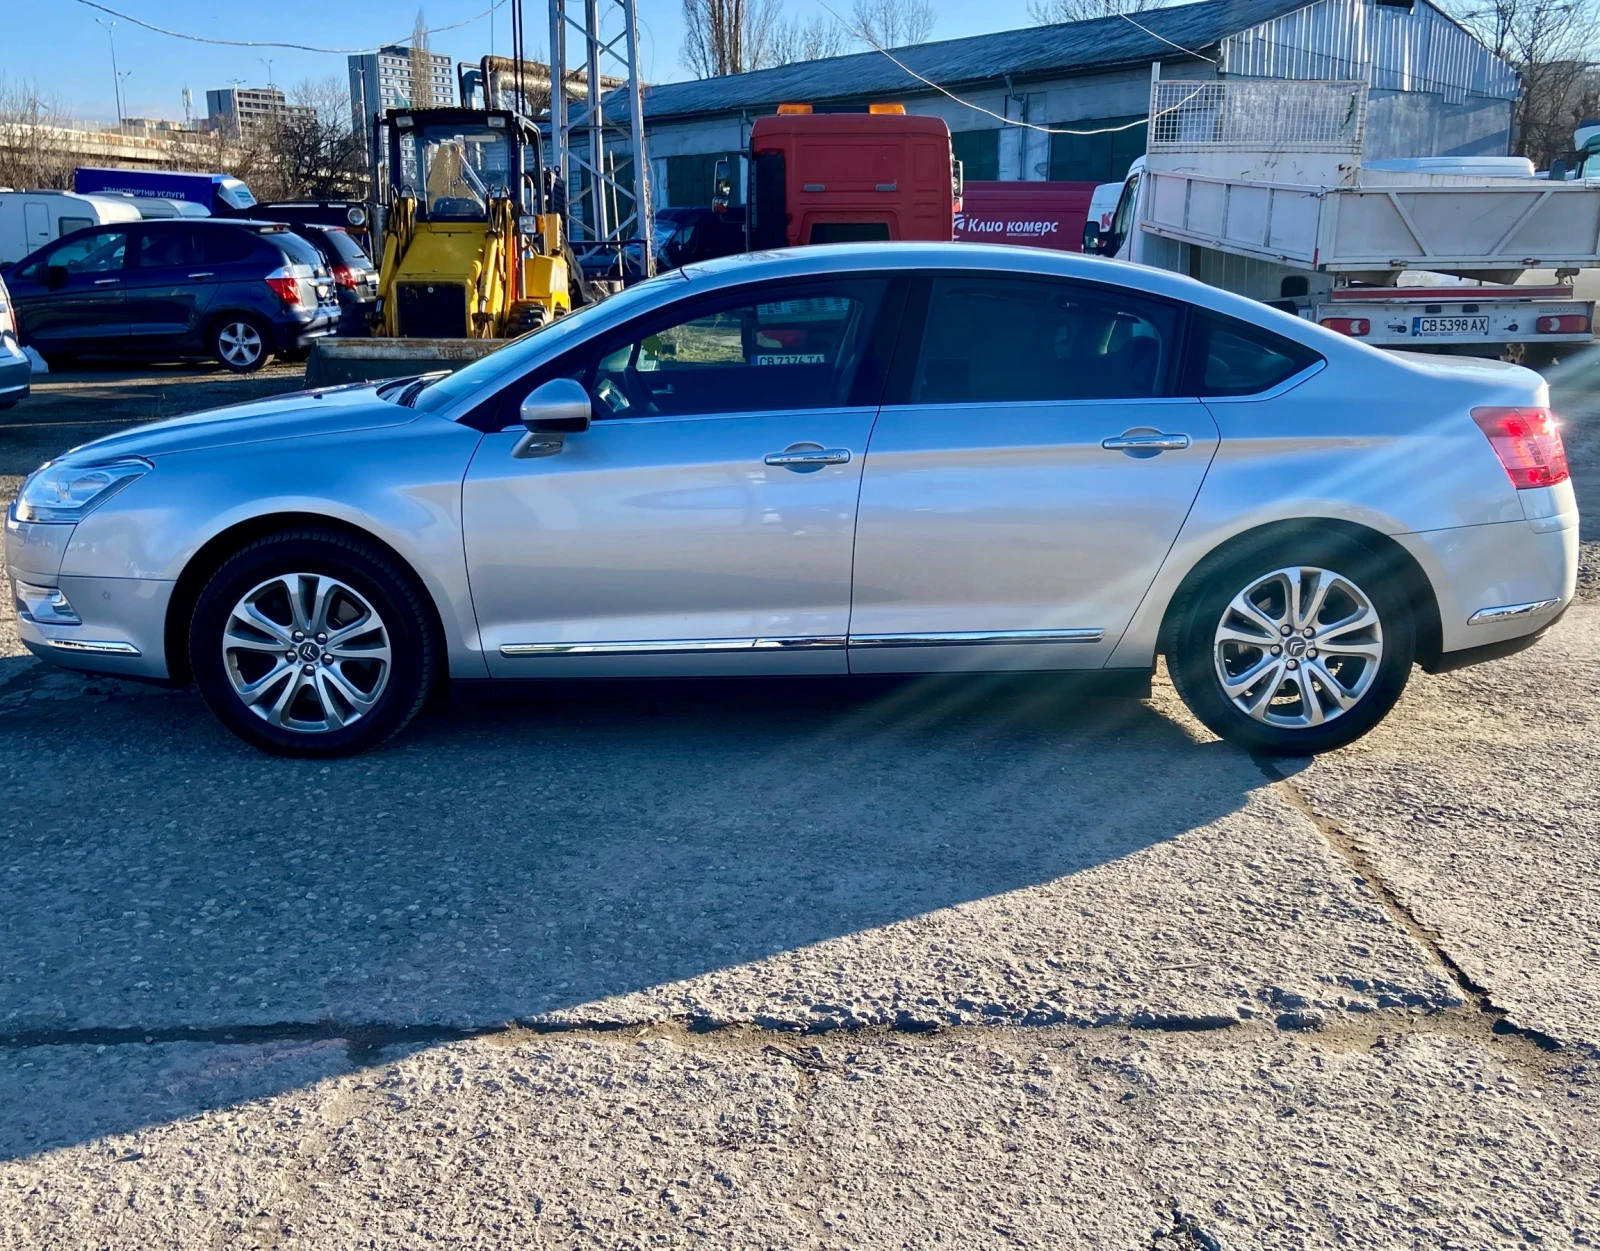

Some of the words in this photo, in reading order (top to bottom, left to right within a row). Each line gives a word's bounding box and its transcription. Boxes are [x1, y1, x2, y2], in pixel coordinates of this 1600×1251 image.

[103, 187, 155, 197] ТРАНСПОРТНИ
[157, 190, 185, 199] УСЛУГИ
[968, 218, 1003, 232] Клио
[1006, 221, 1059, 236] комерс
[1421, 319, 1437, 332] CB
[1439, 319, 1468, 332] 5398
[1470, 318, 1486, 331] AX
